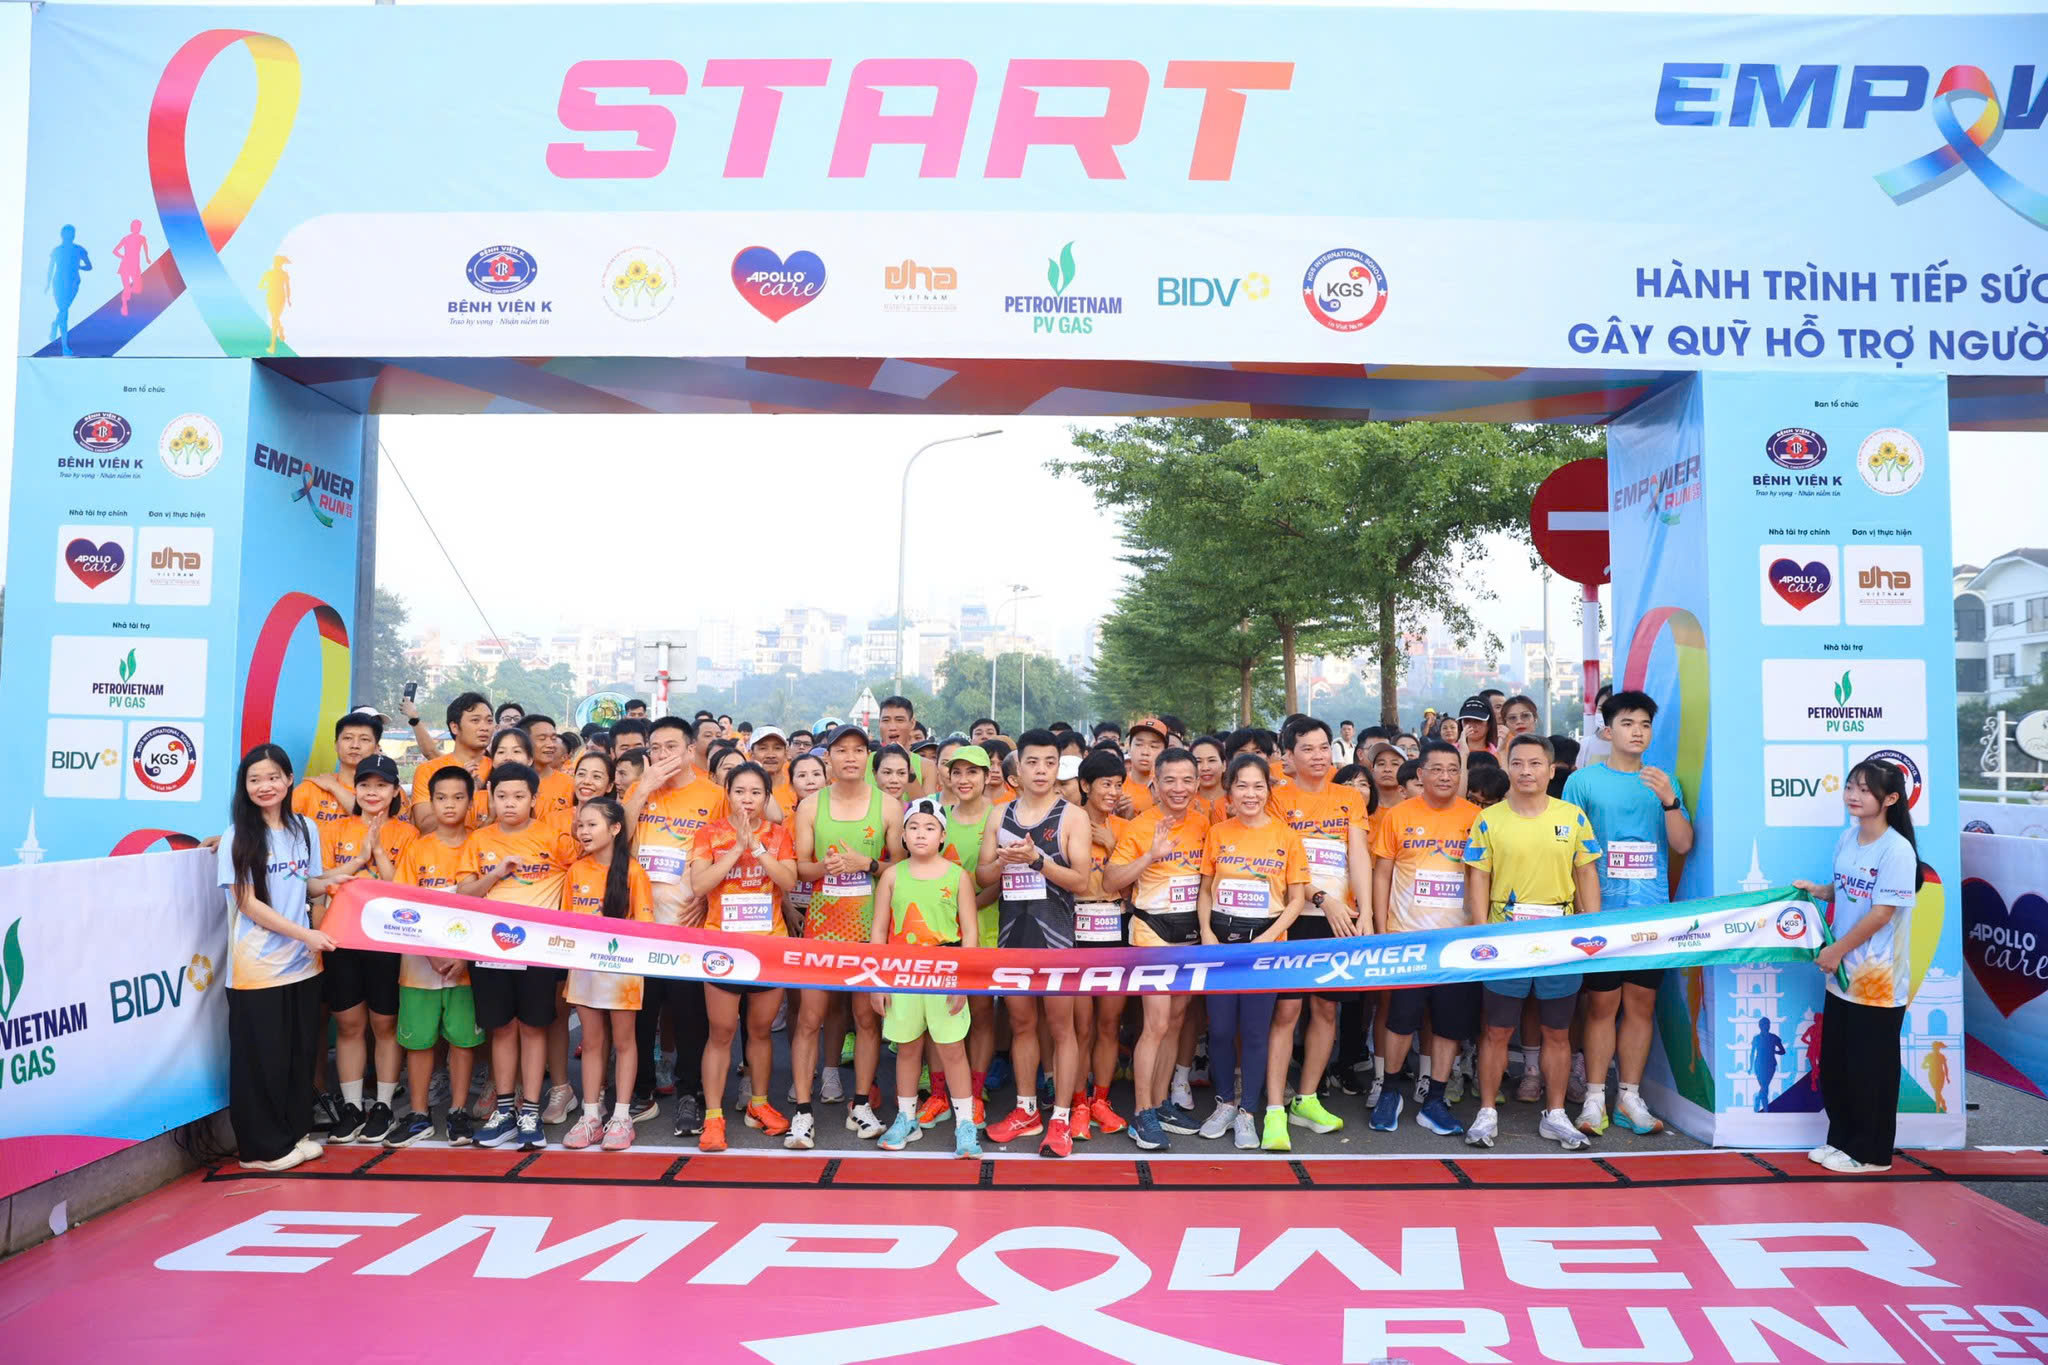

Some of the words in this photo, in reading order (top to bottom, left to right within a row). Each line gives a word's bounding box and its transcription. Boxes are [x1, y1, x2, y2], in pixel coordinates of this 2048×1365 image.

[546, 58, 1295, 181] START
[1314, 251, 1364, 267] INTERNATIONAL
[1364, 258, 1383, 282] SCHOOL
[746, 271, 804, 283] APOLLO
[1636, 259, 1749, 299] HÀNH
[1763, 261, 1876, 301] TRÌNH
[1890, 259, 1967, 302] TIẾP
[759, 281, 822, 296] care
[1157, 277, 1240, 306] BIDV
[1326, 282, 1364, 297] KGS
[447, 299, 492, 316] BỆNH
[497, 299, 535, 316] VIỆN
[541, 300, 552, 312] K
[1004, 296, 1122, 314] PETROVIETNAM
[1033, 316, 1054, 333] PV
[1058, 316, 1093, 334] GAS
[1567, 315, 1654, 354] GÂY
[1667, 319, 1751, 357] QUỸ
[1766, 314, 1825, 358] HỖ
[1838, 325, 1914, 368] TRỢ
[148, 385, 165, 393] chức
[58, 456, 94, 470] BỆNH
[99, 457, 129, 471] VIỆN
[134, 459, 143, 469] K
[254, 443, 354, 500] EMPOWER
[1614, 455, 1700, 512] EMPOWER
[1753, 474, 1791, 487] BỆNH
[1799, 474, 1828, 488] VIỆN
[1833, 475, 1842, 486] K
[319, 494, 344, 516] RUN
[1665, 487, 1691, 510] RUN
[85, 509, 95, 517] tài
[108, 509, 128, 517] chính
[1768, 528, 1784, 536] Nhà
[1786, 528, 1796, 536] tài
[1798, 529, 1808, 537] trợ
[1809, 528, 1830, 536] chính
[1852, 528, 1867, 536] Đơn
[1870, 529, 1876, 537] vị
[1877, 529, 1893, 537] thực
[1895, 528, 1912, 537] hiện
[75, 555, 111, 564] APOLLO
[82, 562, 121, 572] care
[1779, 575, 1817, 584] APOLLO
[1788, 582, 1828, 593] care
[140, 622, 150, 630] trợ
[92, 683, 164, 696] PETROVIETNAM
[109, 696, 122, 707] PV
[125, 697, 145, 708] GAS
[1808, 707, 1882, 718] PETROVIETNAM
[1826, 720, 1840, 732] PV
[1843, 720, 1864, 732] GAS
[52, 750, 100, 770] BIDV
[150, 753, 178, 765] KGS
[1771, 778, 1821, 797] BIDV
[1403, 840, 1466, 849] EMPOWE
[1217, 855, 1284, 870] EMPOWER
[1629, 855, 1654, 863] 58075
[1434, 883, 1461, 892] 51719
[1237, 893, 1265, 902] 52306
[742, 906, 768, 915] 52749
[1724, 921, 1757, 934] BIDV
[1970, 923, 2037, 951] APOLLO
[590, 953, 633, 963] PETROVIETNAM
[648, 952, 679, 966] BIDV
[710, 959, 725, 967] KGS
[783, 951, 958, 974] EMPOWER
[1253, 944, 1427, 970] EMPOWER
[1984, 944, 2048, 980] care
[894, 973, 942, 988] RUN
[988, 962, 1224, 991] START
[110, 965, 187, 1024] BIDV
[0, 1002, 88, 1050] VIETNAM
[11, 1045, 56, 1085] GAS
[154, 1210, 1962, 1290] EMPOWER
[1344, 1306, 1907, 1365] RUN
[1952, 1335, 2048, 1365] 2
